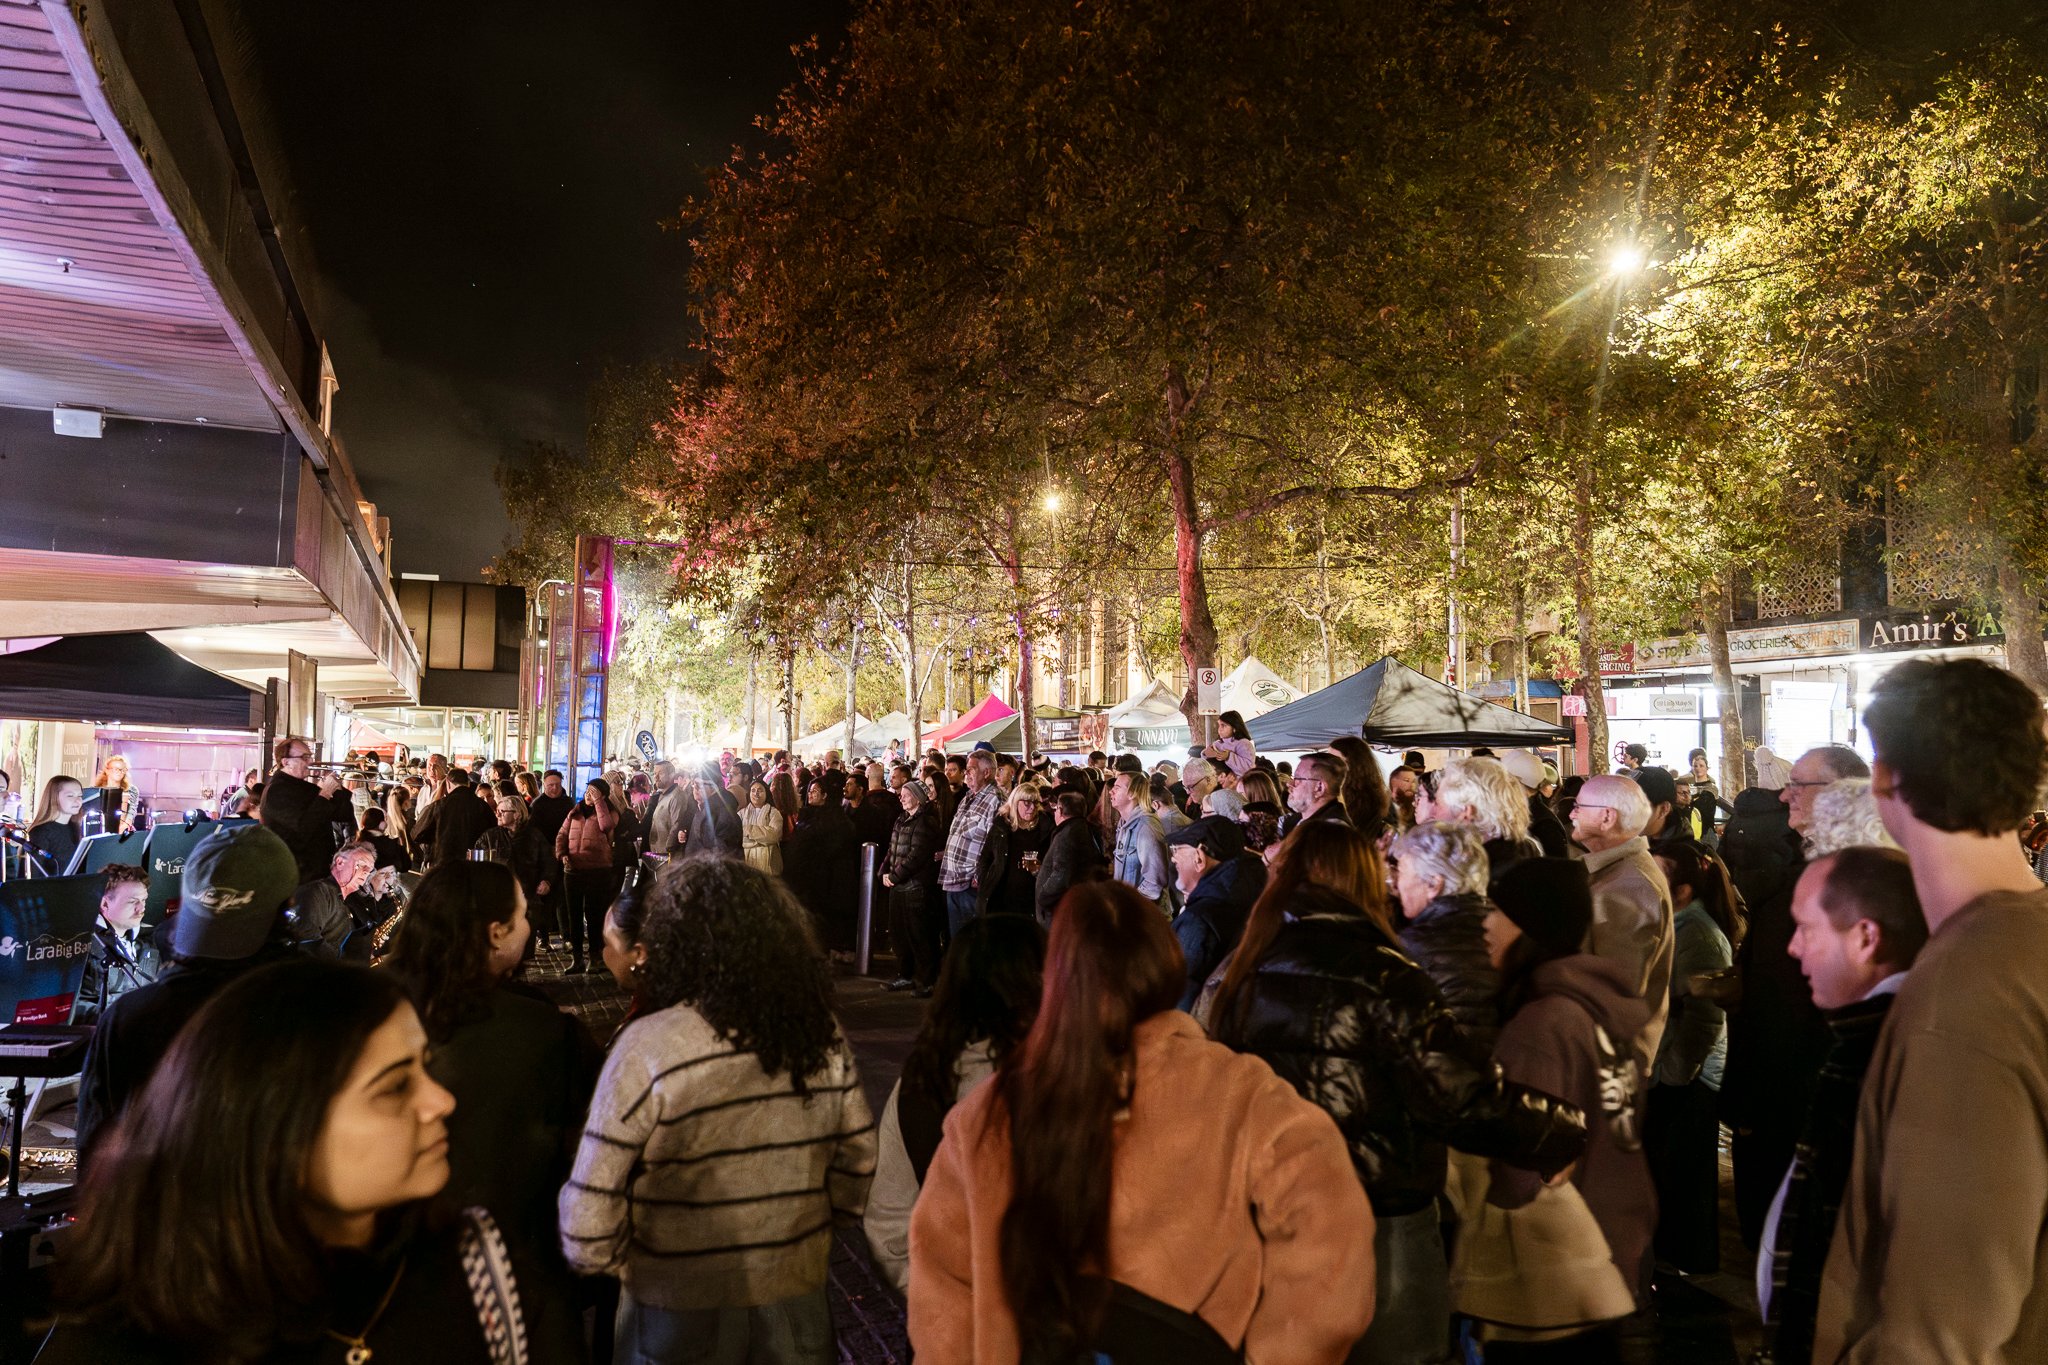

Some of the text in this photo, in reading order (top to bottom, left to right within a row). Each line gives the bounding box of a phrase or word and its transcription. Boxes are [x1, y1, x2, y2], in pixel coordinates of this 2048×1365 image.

[1869, 612, 1967, 648] Amir's
[1730, 637, 1788, 652] GROCERIES
[1599, 662, 1631, 672] ERCING
[1137, 728, 1179, 746] UNNAVU
[26, 944, 55, 961] Lara
[56, 943, 72, 959] Big
